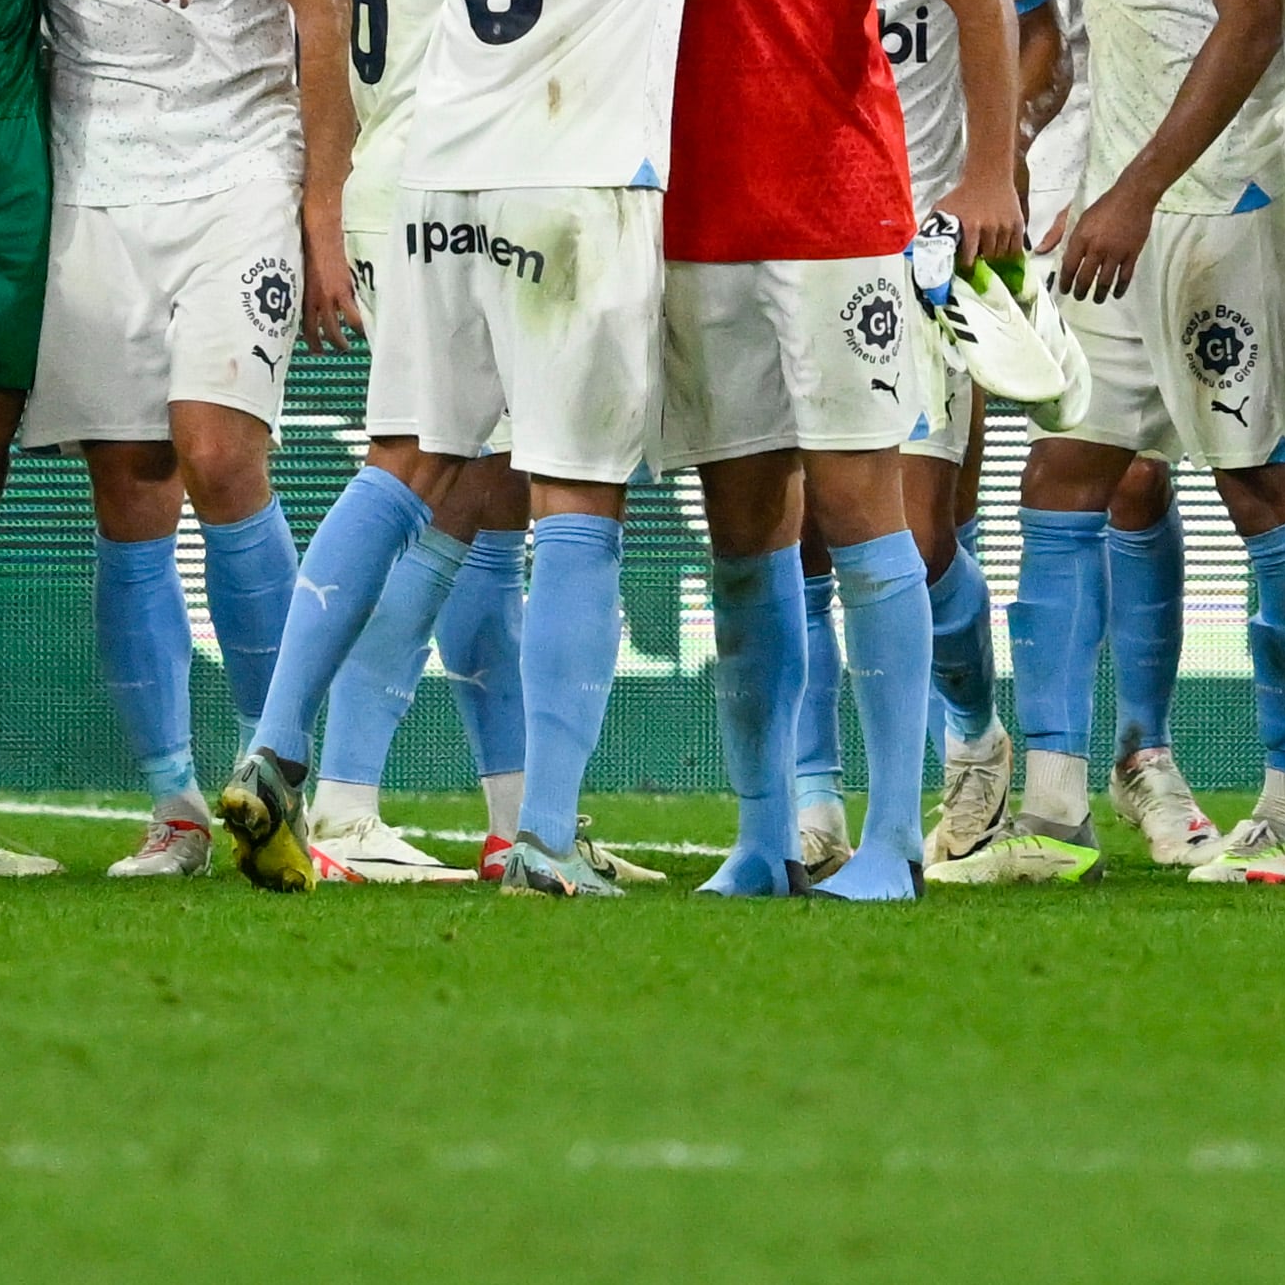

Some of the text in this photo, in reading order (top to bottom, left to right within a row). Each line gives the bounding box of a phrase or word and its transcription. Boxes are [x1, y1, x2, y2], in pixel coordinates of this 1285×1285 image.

[241, 257, 276, 284] Costa
[240, 292, 266, 332] Pirineu
[268, 328, 280, 338] de
[840, 278, 903, 321] Costa Brava
[1182, 305, 1254, 345] Costa Brava
[843, 329, 876, 364] Pirineu
[879, 355, 890, 365] de
[1218, 379, 1232, 390] de
[1234, 343, 1259, 382] Girona
